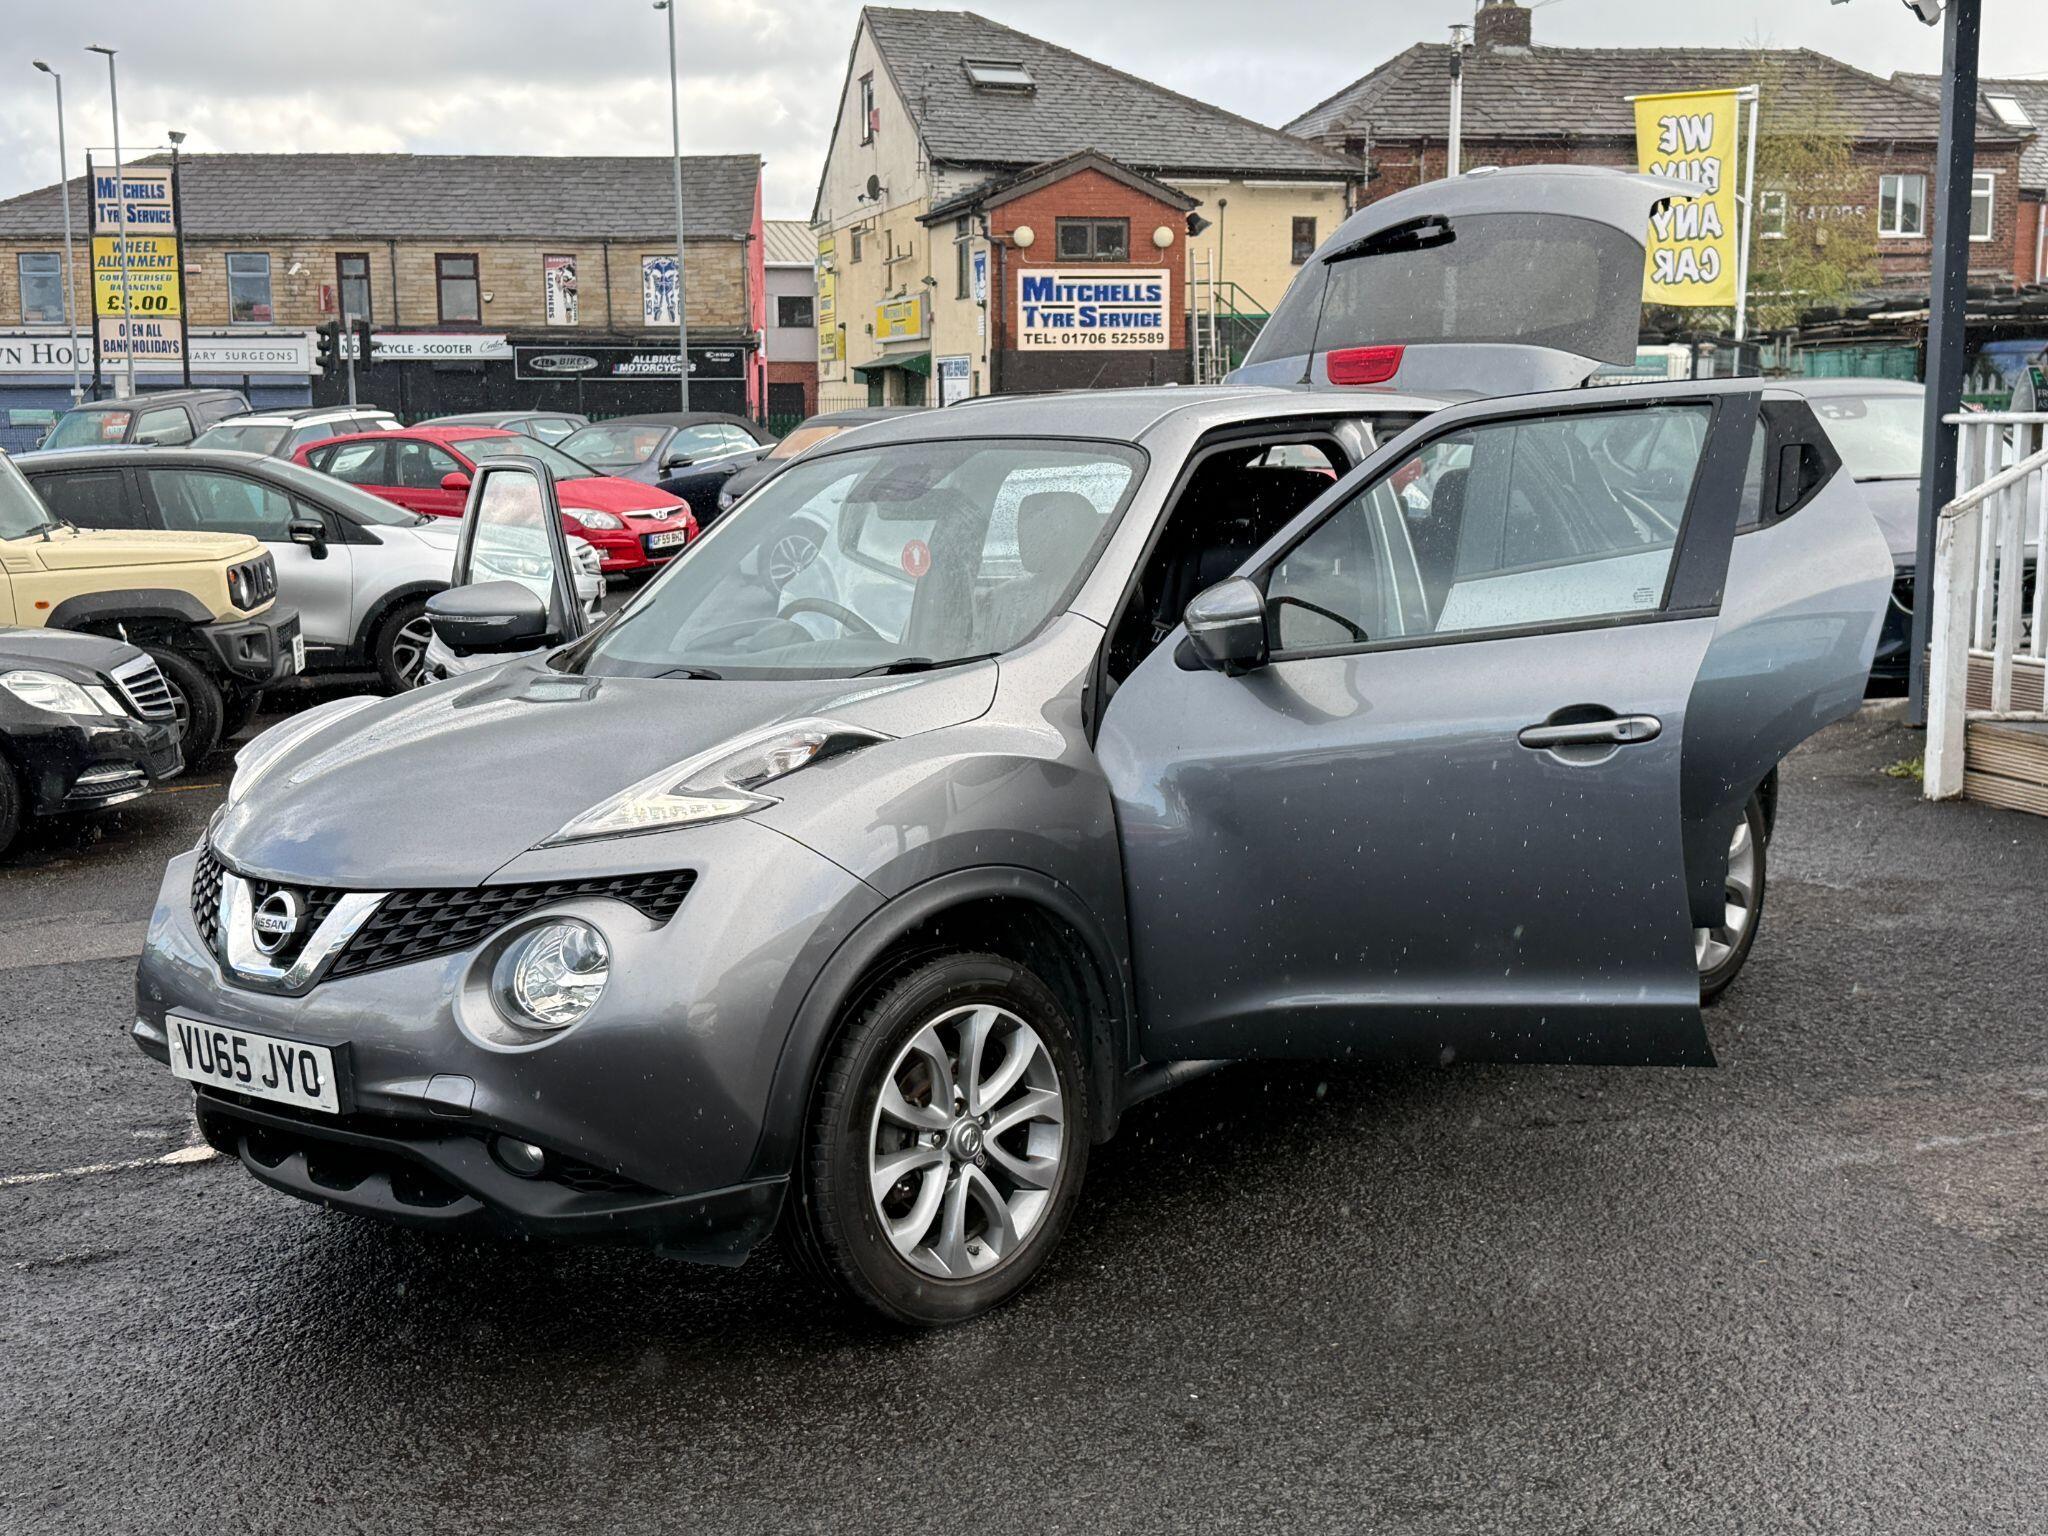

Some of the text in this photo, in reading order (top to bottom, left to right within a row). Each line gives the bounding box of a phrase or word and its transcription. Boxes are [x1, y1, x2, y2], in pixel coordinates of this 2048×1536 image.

[97, 177, 165, 199] MICHELLS
[98, 203, 171, 223] TYR SERVICE
[112, 241, 158, 253] WHEEL
[547, 272, 555, 319] LEATHERS
[1022, 276, 1162, 302] MITCHELLS
[1022, 305, 1162, 328] TYRE SERVICE
[119, 323, 162, 337] OEN ALL
[1024, 332, 1164, 344] TEL: 01706 525589
[132, 339, 180, 354] HOLIDAYS
[423, 344, 472, 354] SCOOTER
[225, 351, 293, 361] SURGEONS
[559, 357, 589, 366] BIKES
[632, 355, 683, 364] ALLBIKES
[619, 363, 697, 373] MOTORCYCLS
[254, 916, 288, 931] NISSAN
[177, 1023, 321, 1098] VU65 JYO
